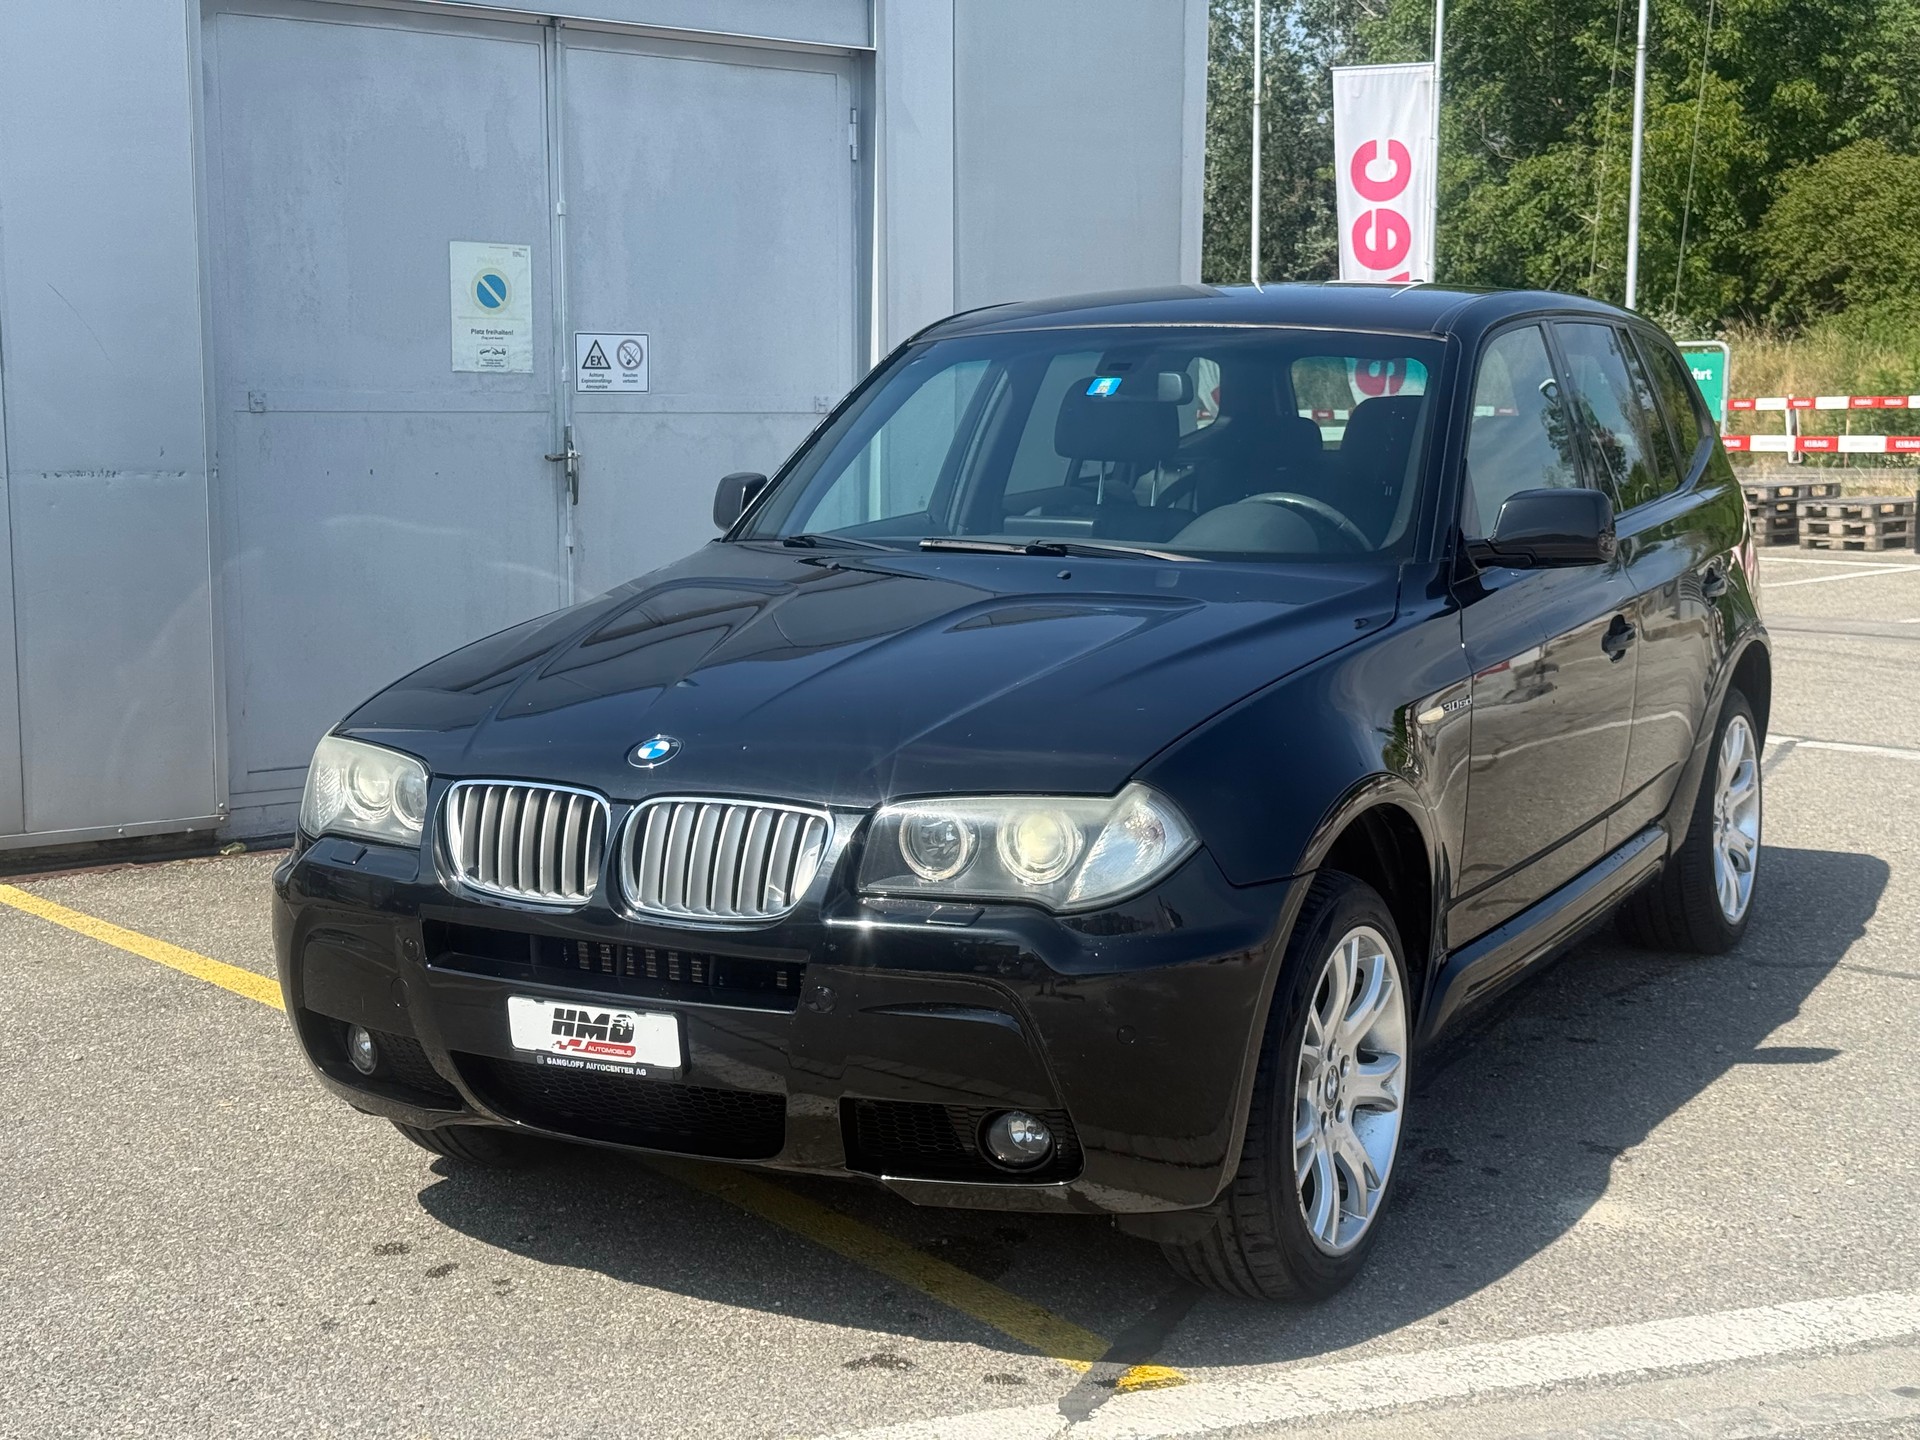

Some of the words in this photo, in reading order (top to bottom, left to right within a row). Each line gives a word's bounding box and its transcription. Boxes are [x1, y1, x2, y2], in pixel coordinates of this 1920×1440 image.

[485, 328, 514, 336] freihalten!
[590, 355, 603, 366] EX
[1803, 439, 1829, 448] KIBAG
[546, 1057, 585, 1069] GANGLOFF
[585, 1062, 635, 1076] AUTOCENTER
[635, 1068, 647, 1076] AG
